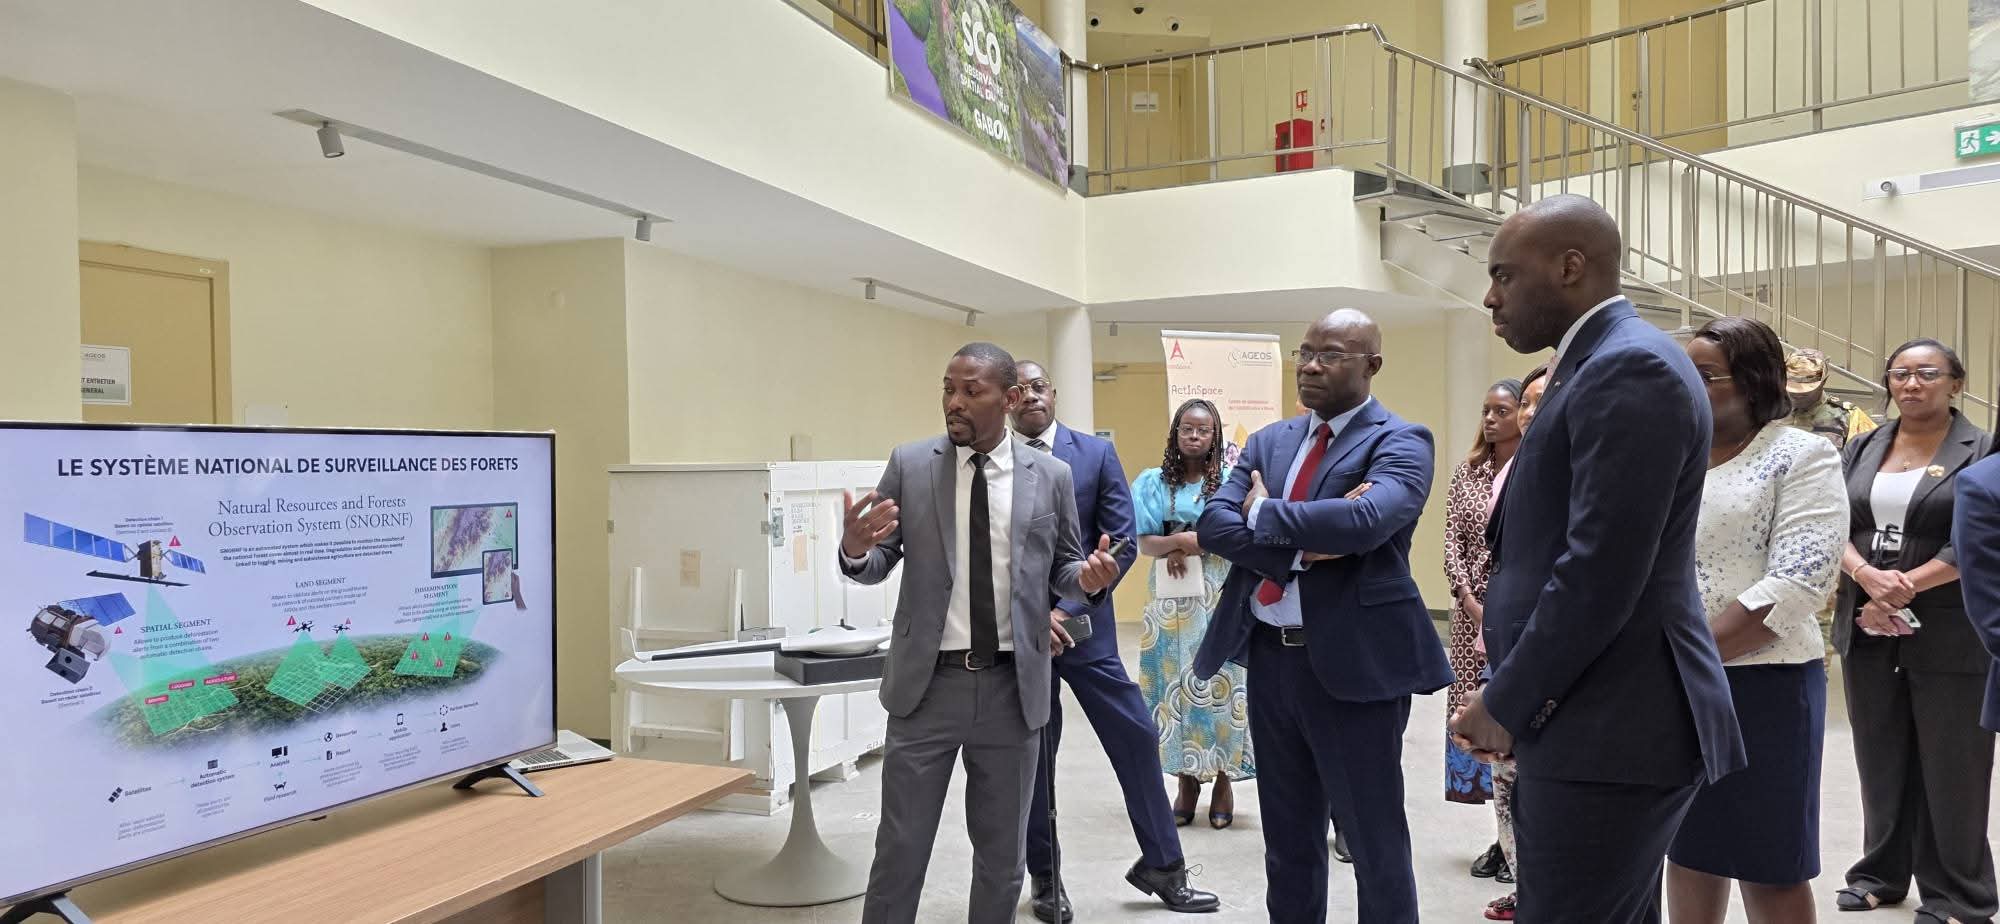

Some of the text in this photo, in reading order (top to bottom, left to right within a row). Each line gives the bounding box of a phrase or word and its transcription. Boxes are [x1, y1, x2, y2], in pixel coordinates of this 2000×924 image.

[961, 11, 1001, 76] SCO
[1241, 351, 1272, 360] AGEOS
[57, 454, 519, 477] LE SYSTÈME NATIONAL DE SURVEILLANCE DES FORETS
[218, 494, 406, 515] Natural Resources and Forests
[208, 511, 413, 537] Observation System (SNORNF)
[295, 576, 346, 589] LAND SEGMENT
[423, 590, 449, 600] SEGMENT
[140, 618, 211, 634] SPATIAL SEGMENT
[183, 630, 218, 639] deforestation
[270, 759, 290, 769] Analysis
[190, 773, 235, 789] detection system
[199, 768, 228, 780] Automatic
